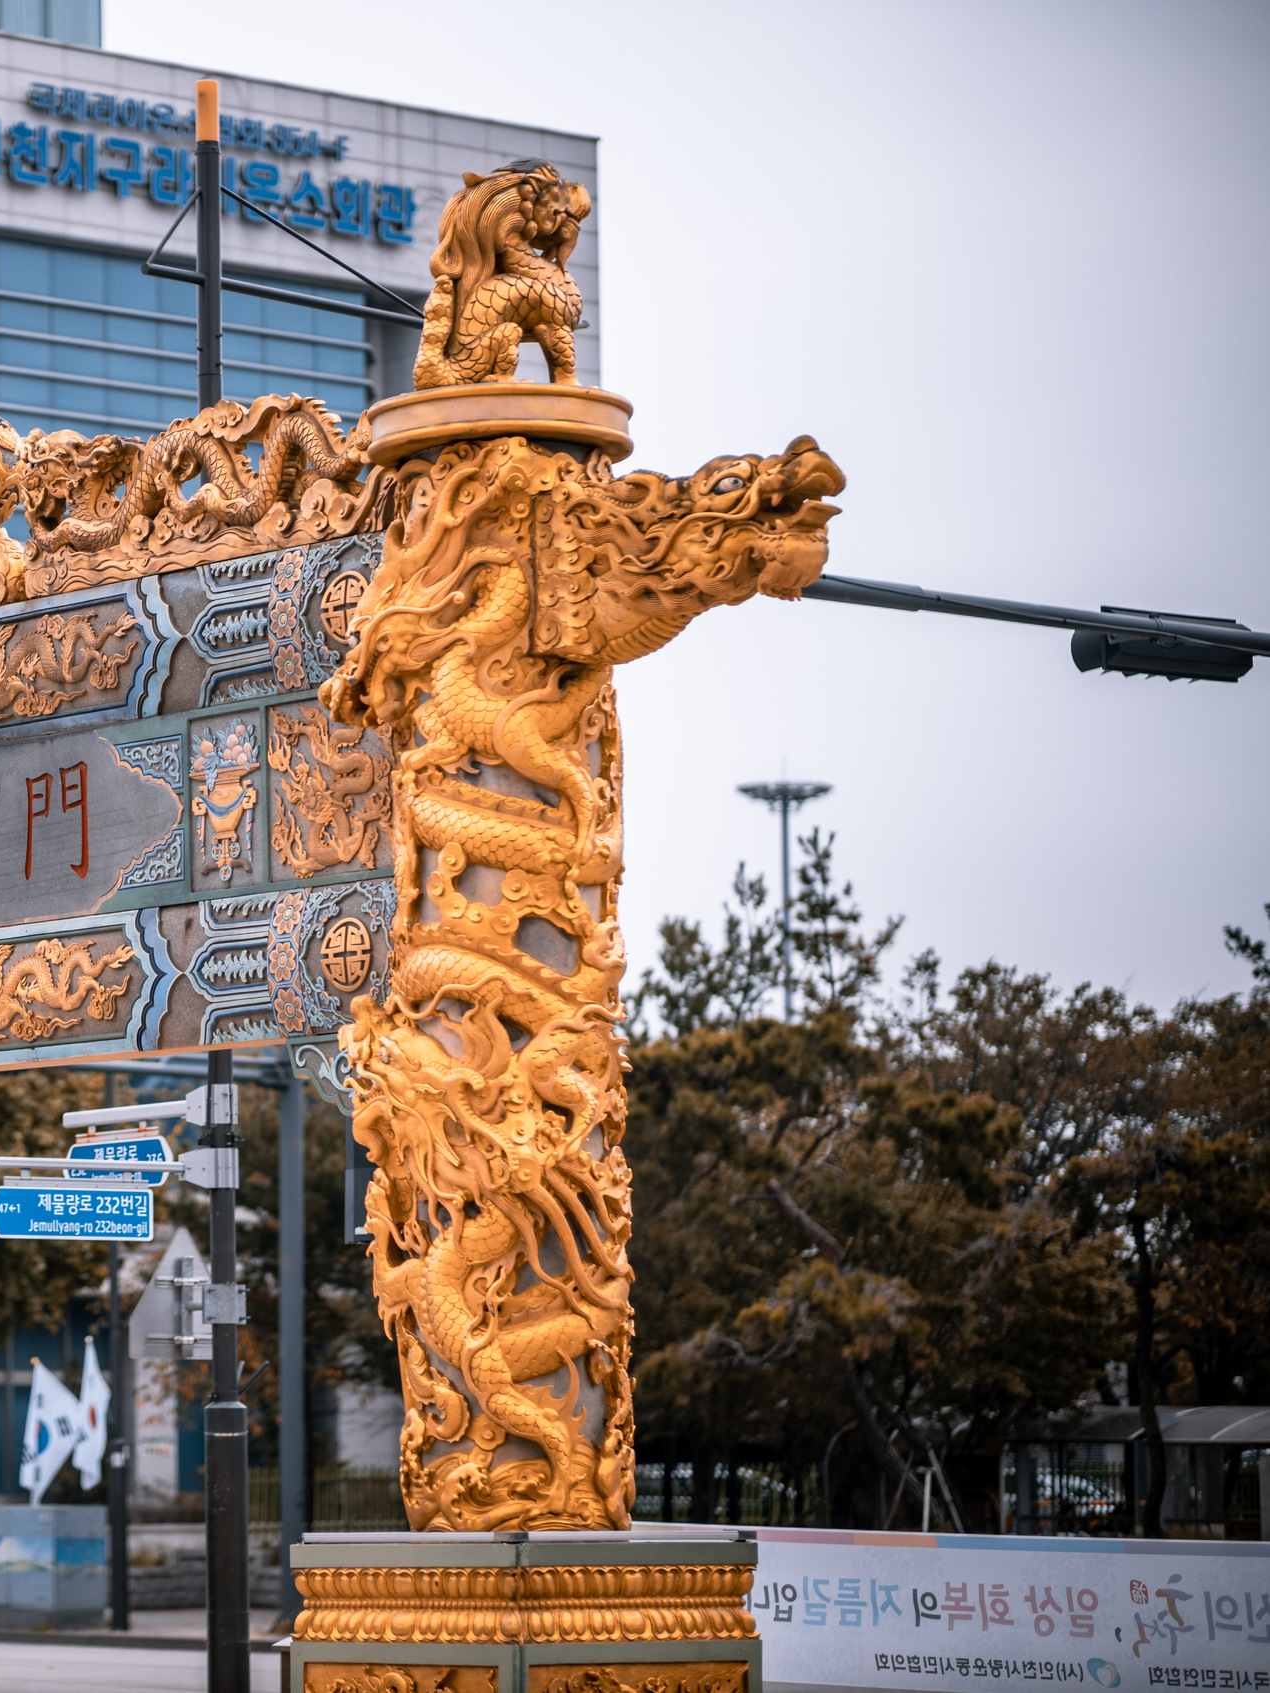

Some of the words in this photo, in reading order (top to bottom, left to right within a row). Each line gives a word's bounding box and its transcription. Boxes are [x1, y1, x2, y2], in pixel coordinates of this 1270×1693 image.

[37, 1193, 94, 1216] 제물량로
[95, 1195, 148, 1217] 232번길
[28, 1219, 93, 1236] Jemullyang-ro
[95, 1220, 148, 1237] 232beon-gil
